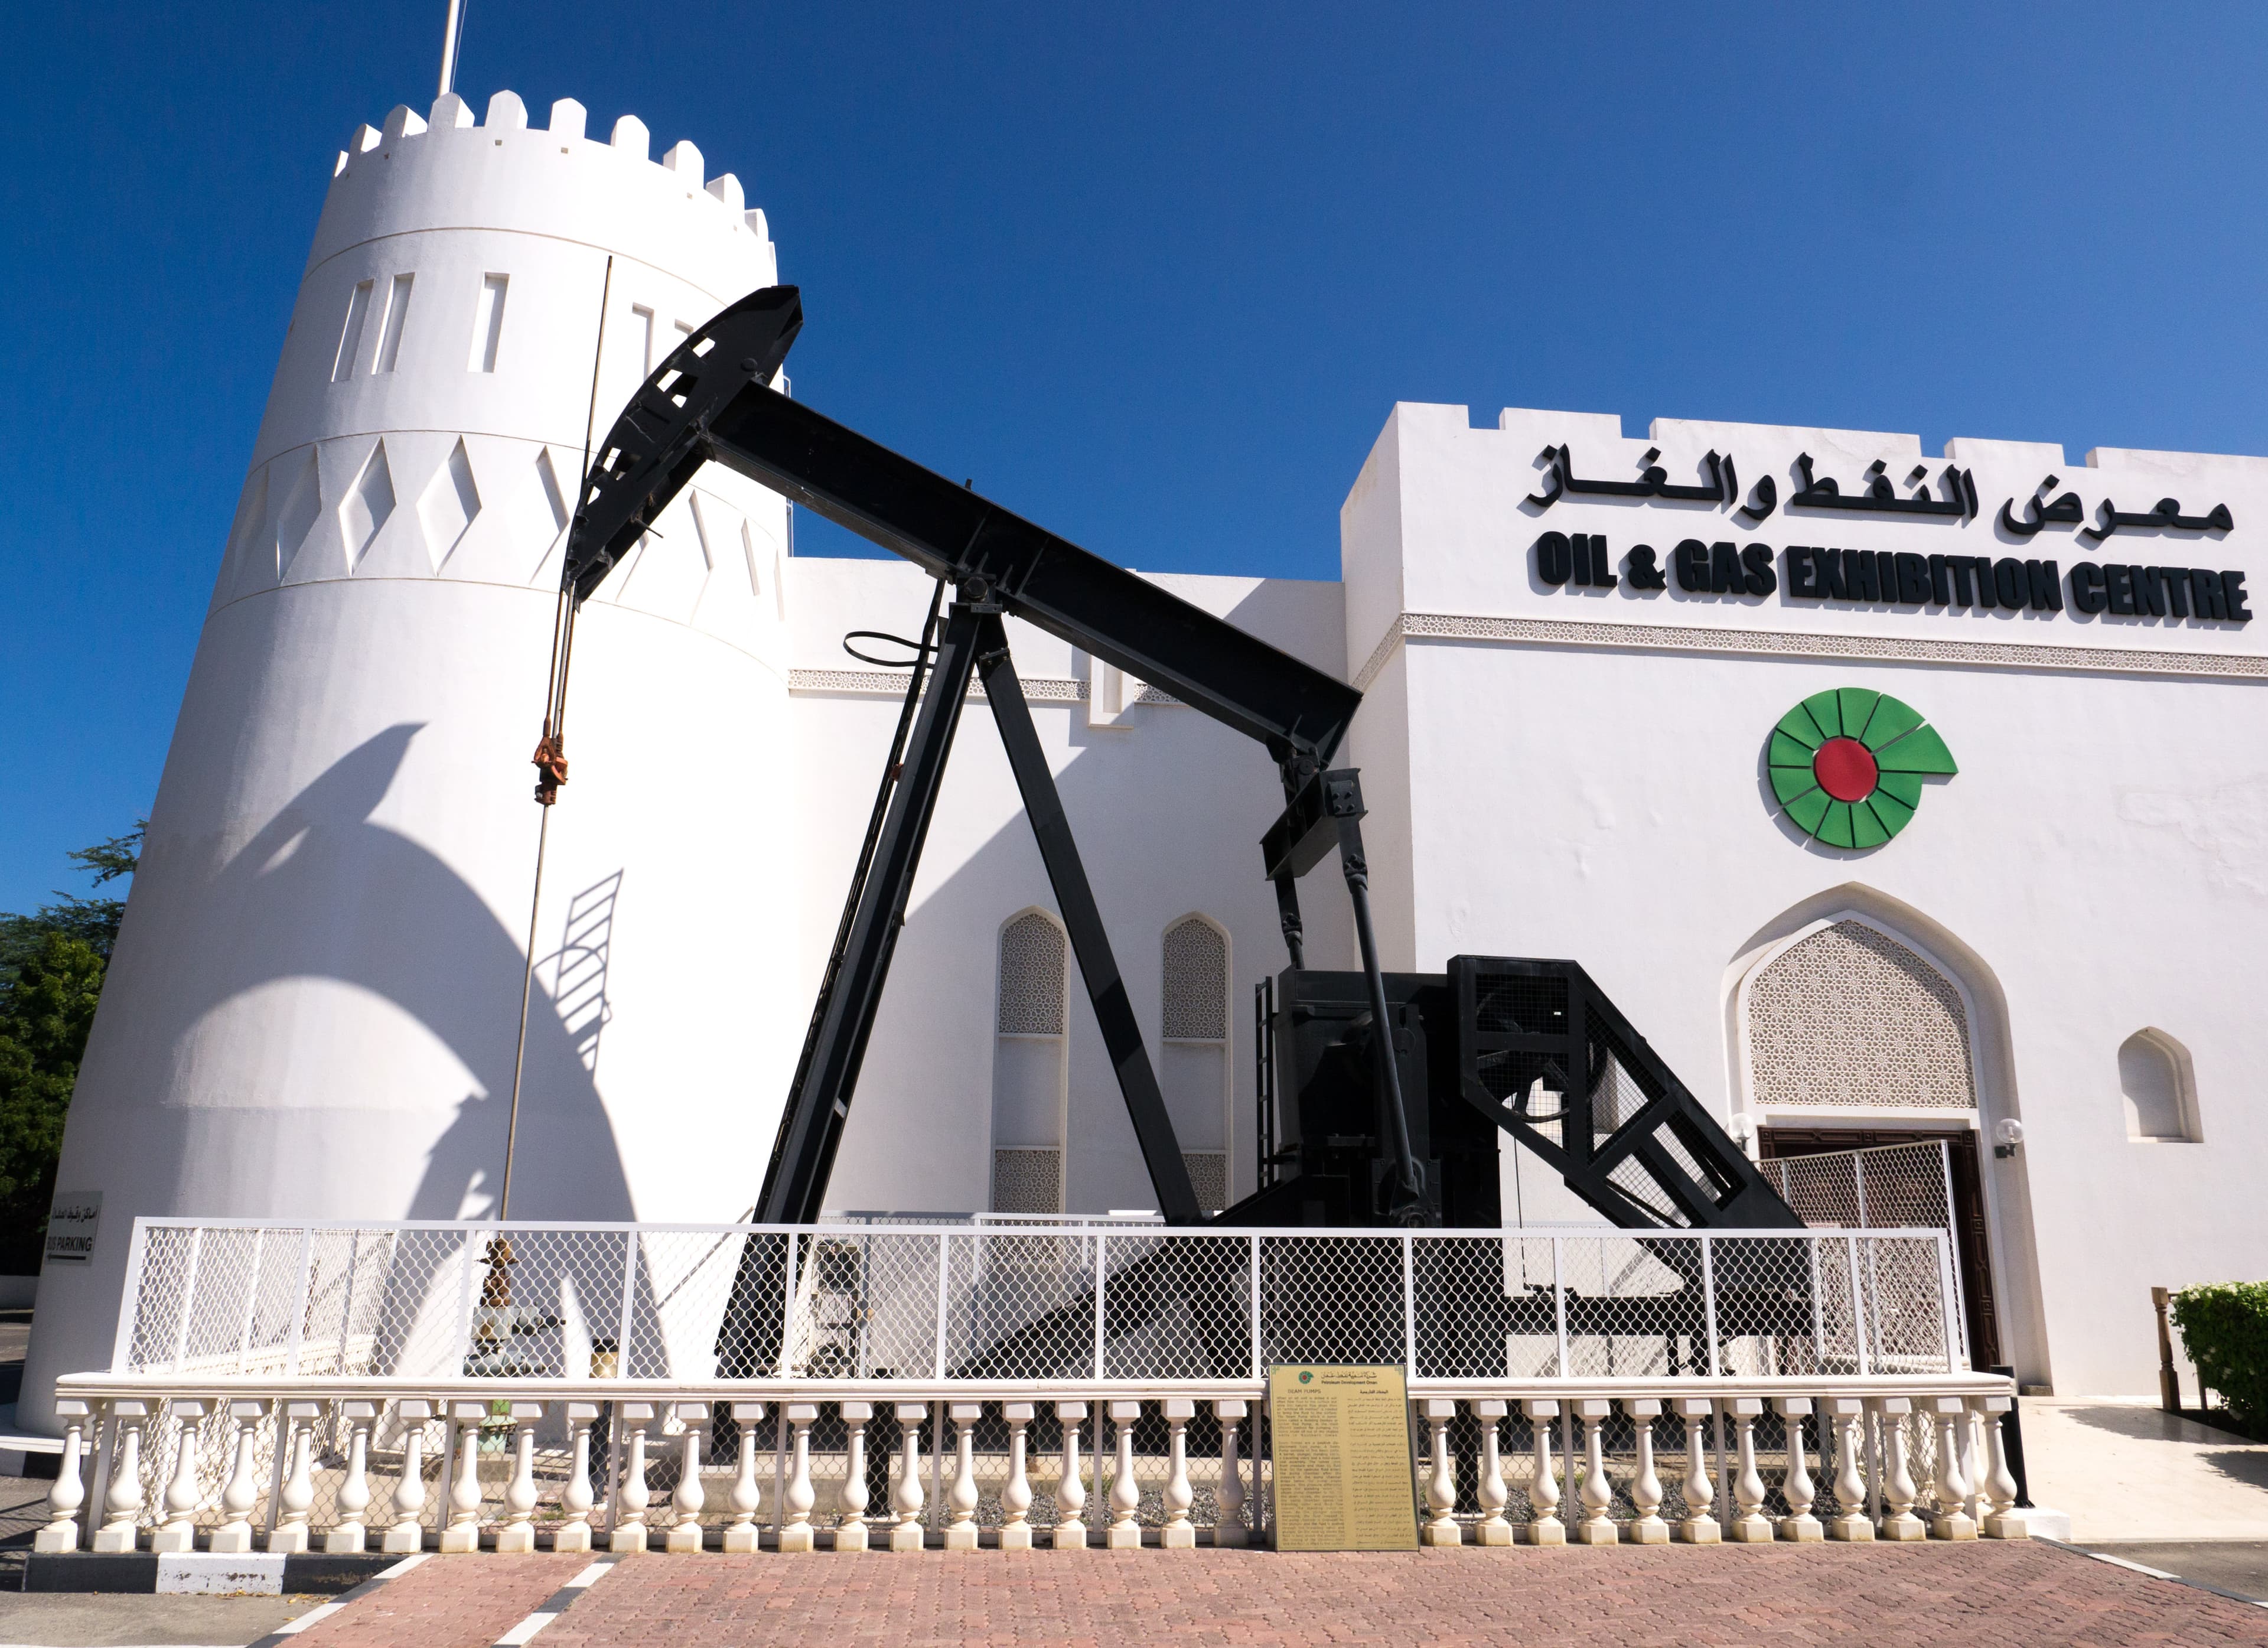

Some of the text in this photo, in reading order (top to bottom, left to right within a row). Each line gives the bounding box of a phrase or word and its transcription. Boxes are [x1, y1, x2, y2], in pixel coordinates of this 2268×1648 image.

[1527, 443, 2234, 540] معرض النفط والغاز
[1537, 531, 2253, 621] OIL & GAS EXHIBITION CENTRE
[57, 1236, 93, 1252] PARKING
